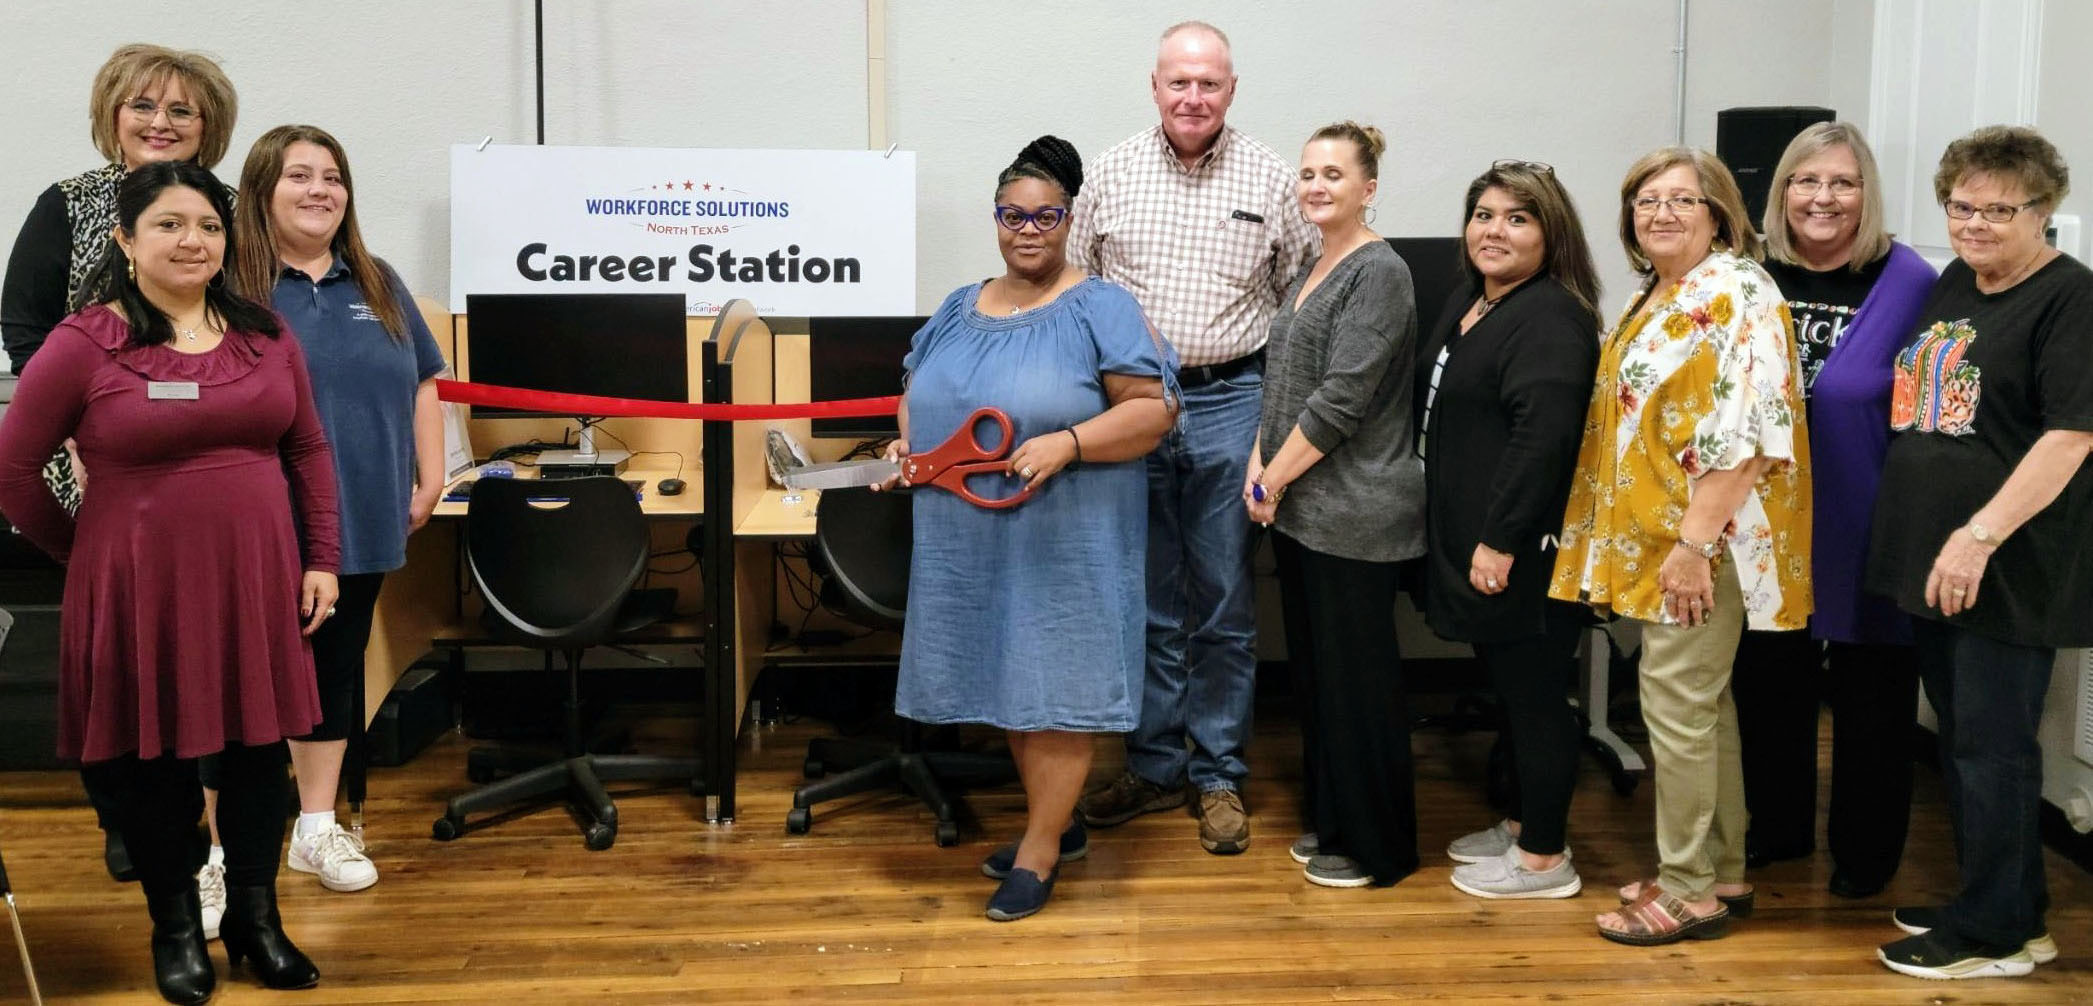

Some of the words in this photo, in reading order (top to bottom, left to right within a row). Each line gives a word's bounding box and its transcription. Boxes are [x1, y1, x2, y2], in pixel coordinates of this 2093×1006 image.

[586, 199, 691, 216] WORKFORCE
[695, 200, 789, 218] SOLUTIONS
[647, 223, 688, 236] NORTH
[691, 224, 729, 236] TEXAS
[516, 242, 677, 282] Career
[687, 243, 861, 283] Station
